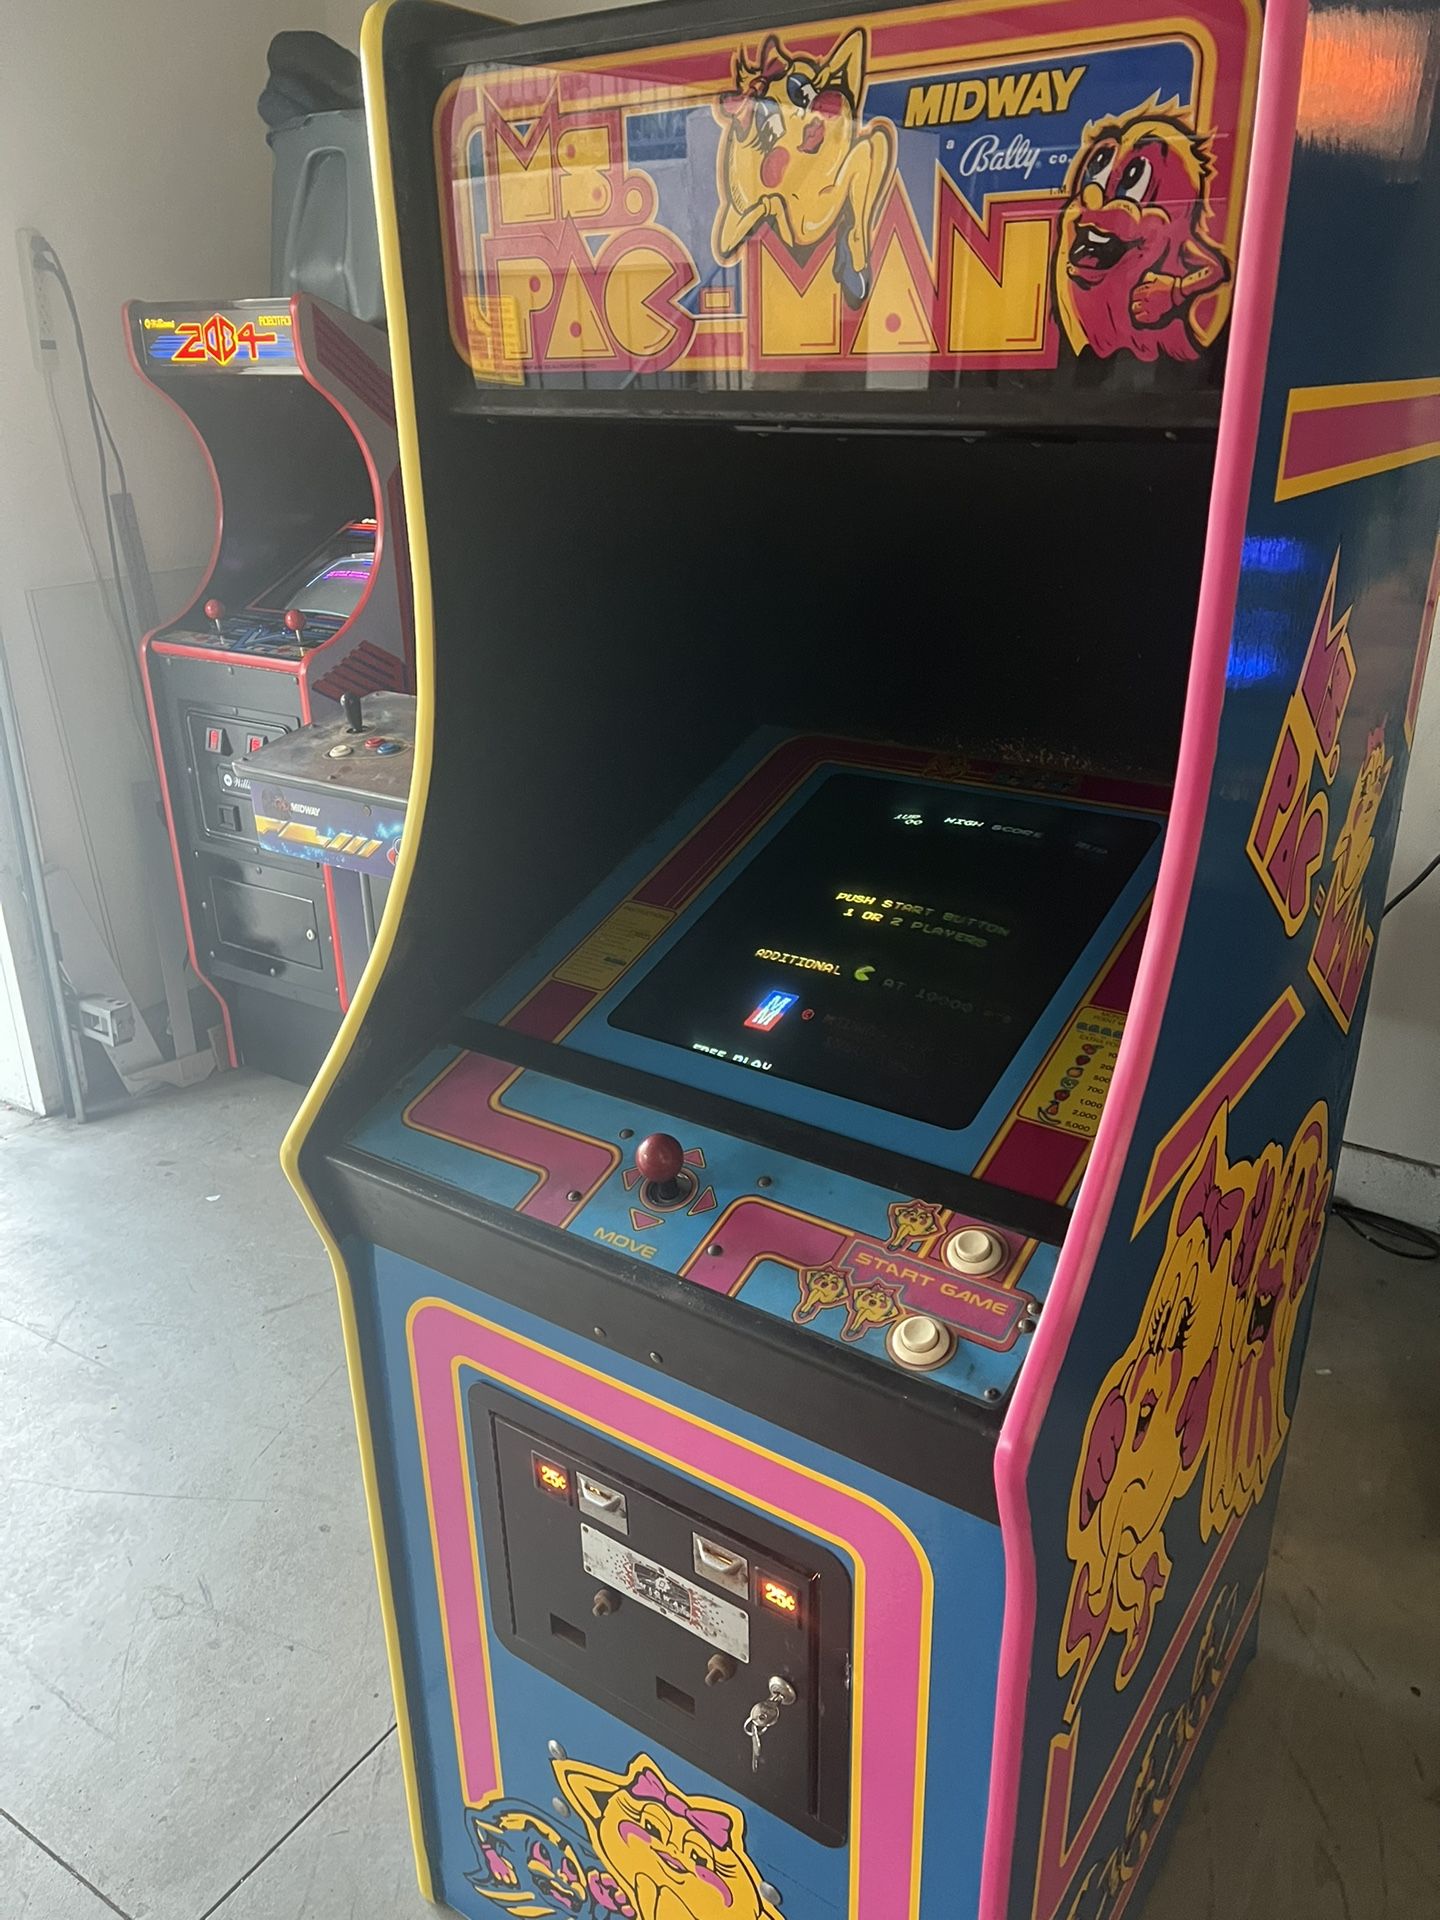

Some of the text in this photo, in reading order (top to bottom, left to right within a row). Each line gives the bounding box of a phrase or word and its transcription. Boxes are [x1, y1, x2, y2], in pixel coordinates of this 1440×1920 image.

[904, 65, 1087, 128] MIDWAY
[945, 139, 955, 150] a
[171, 313, 278, 366] 2084
[233, 776, 251, 790] Willi
[290, 802, 320, 817] MIDWAY
[944, 816, 985, 828] HIGH
[991, 824, 1044, 838] SCORE
[835, 892, 1010, 937] PUSH START BUTTON
[842, 908, 988, 948] 1 OR 2 PLAYERS
[755, 948, 842, 977] ADDITIONAL
[882, 978, 907, 991] AT
[1087, 1086, 1104, 1095] 700
[594, 1226, 658, 1260] MOVE
[855, 1252, 1009, 1317] START GAME
